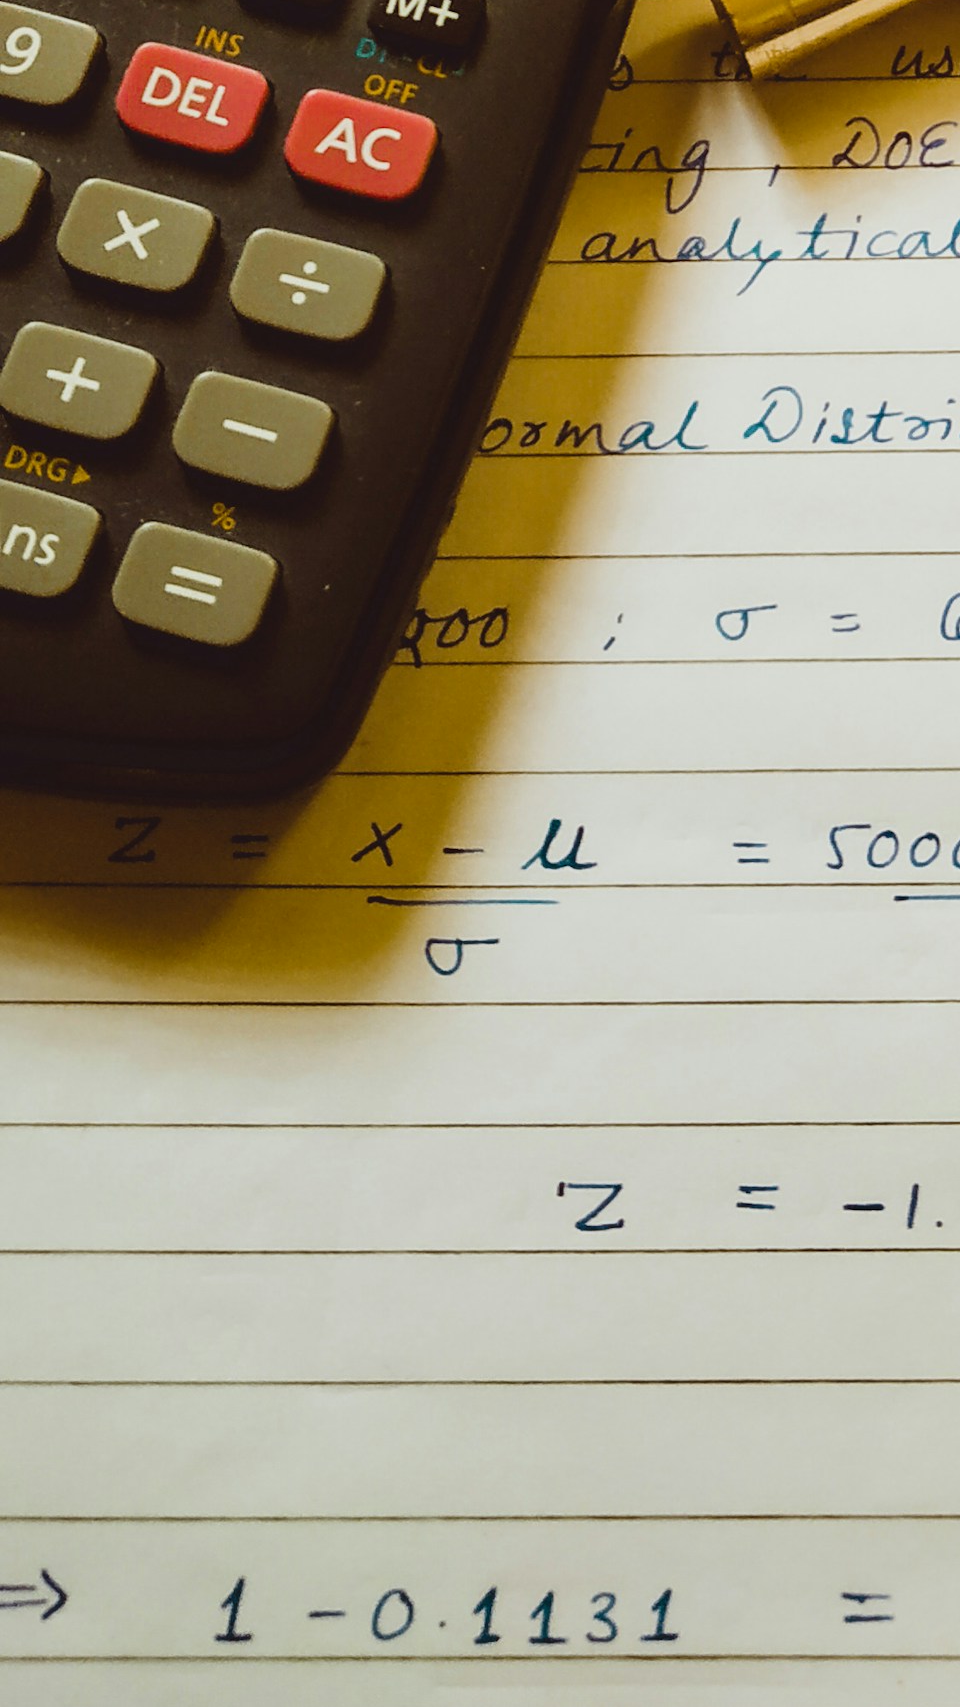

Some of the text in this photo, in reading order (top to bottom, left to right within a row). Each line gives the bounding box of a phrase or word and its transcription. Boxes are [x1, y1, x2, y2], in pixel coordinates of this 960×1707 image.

[0, 26, 42, 76] 9
[195, 25, 244, 58] INS
[141, 66, 231, 128] DEL
[364, 73, 420, 106] OFF
[314, 116, 403, 172] AC
[582, 127, 712, 215] ting
[832, 116, 959, 172] DOE
[474, 400, 711, 455] ormal
[3, 445, 68, 484] DRG
[211, 501, 238, 532] %
[1, 520, 60, 567] ns
[214, 1576, 253, 1643] 1
